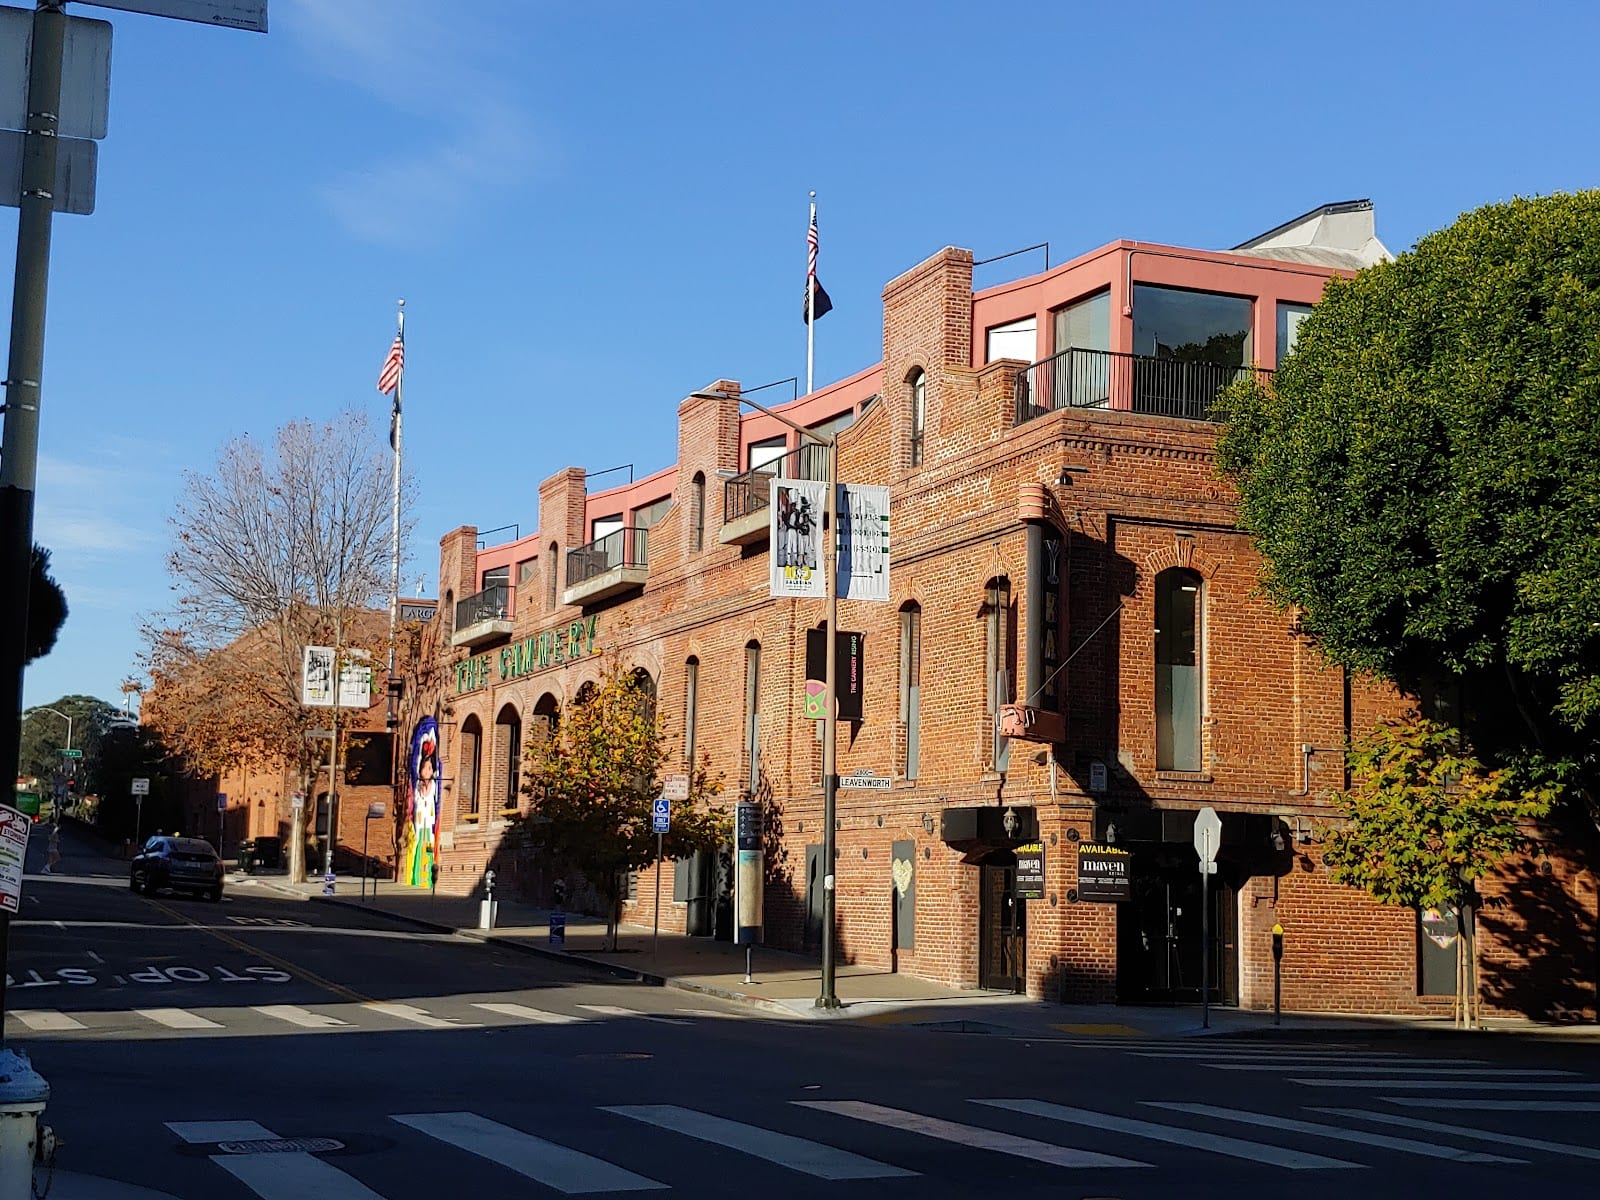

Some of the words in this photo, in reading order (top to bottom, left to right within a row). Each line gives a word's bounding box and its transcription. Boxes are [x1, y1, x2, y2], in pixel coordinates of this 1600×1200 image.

[454, 655, 491, 693] THE
[498, 614, 598, 680] CANNERY
[841, 778, 890, 788] LEAVENWORTH
[1082, 860, 1125, 872] maven
[129, 966, 293, 983] STOP
